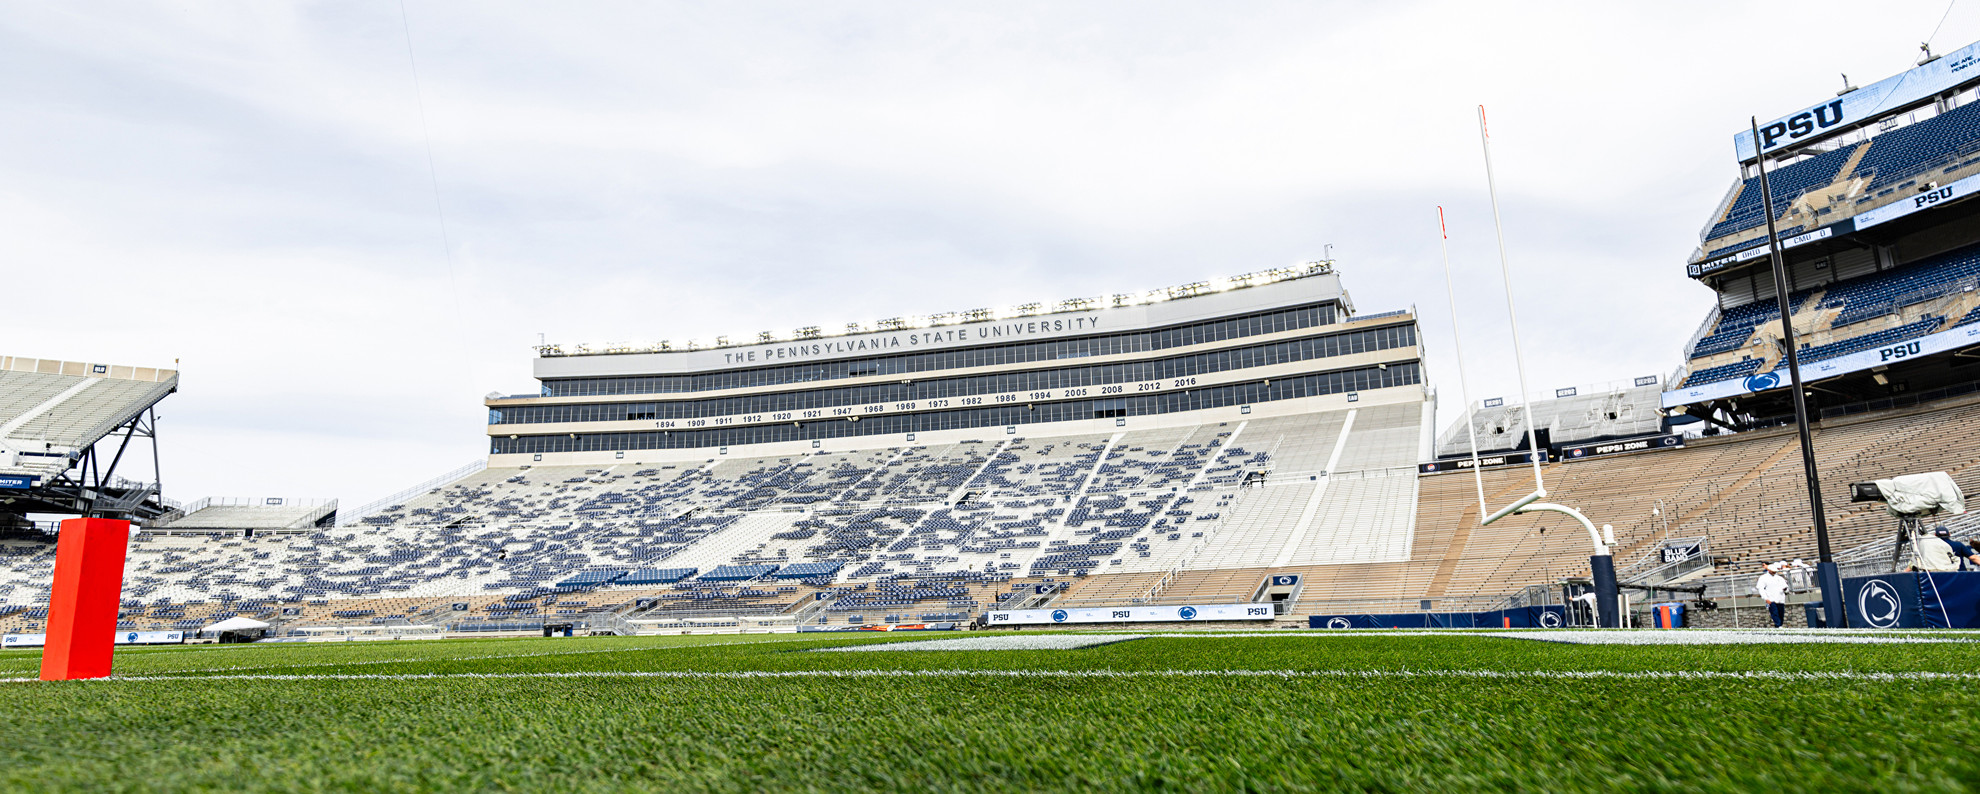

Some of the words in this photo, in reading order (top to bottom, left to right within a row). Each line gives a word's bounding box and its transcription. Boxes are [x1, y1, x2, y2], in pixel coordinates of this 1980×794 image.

[1760, 99, 1843, 150] PSU
[1914, 185, 1953, 208] PSU
[1793, 234, 1811, 245] CMU
[1741, 248, 1761, 259] OHIO
[1701, 256, 1736, 270] MITER
[725, 351, 756, 364] THE
[765, 336, 900, 360] PENNSYLVANIA
[910, 329, 967, 345] STATE
[979, 316, 1099, 338] UNIVERSITY
[1880, 341, 1921, 362] PSU
[687, 419, 706, 427] 1909
[715, 417, 732, 425] 1911
[743, 415, 762, 423] 1912
[772, 412, 792, 421] 1920
[802, 410, 822, 418] 1921
[832, 407, 852, 416] 1947
[864, 405, 884, 413] 1968
[896, 402, 916, 411] 1969
[928, 399, 949, 408] 1973
[961, 397, 982, 405] 1982
[995, 394, 1016, 402] 1986
[1029, 391, 1051, 400] 1994
[1064, 388, 1087, 397] 2005
[1101, 385, 1123, 394] 2008
[1138, 382, 1161, 391] 2012
[1174, 377, 1197, 387] 2016
[1596, 444, 1623, 454] PEPSI
[1623, 440, 1648, 451] ZONE
[1457, 459, 1482, 468] PEPI
[1482, 457, 1504, 466] ZONE
[1664, 547, 1686, 555] BLUE
[1664, 554, 1689, 562] BAND
[992, 613, 1010, 621] PSU
[1112, 610, 1130, 618] PSU
[1247, 607, 1268, 616] PSU
